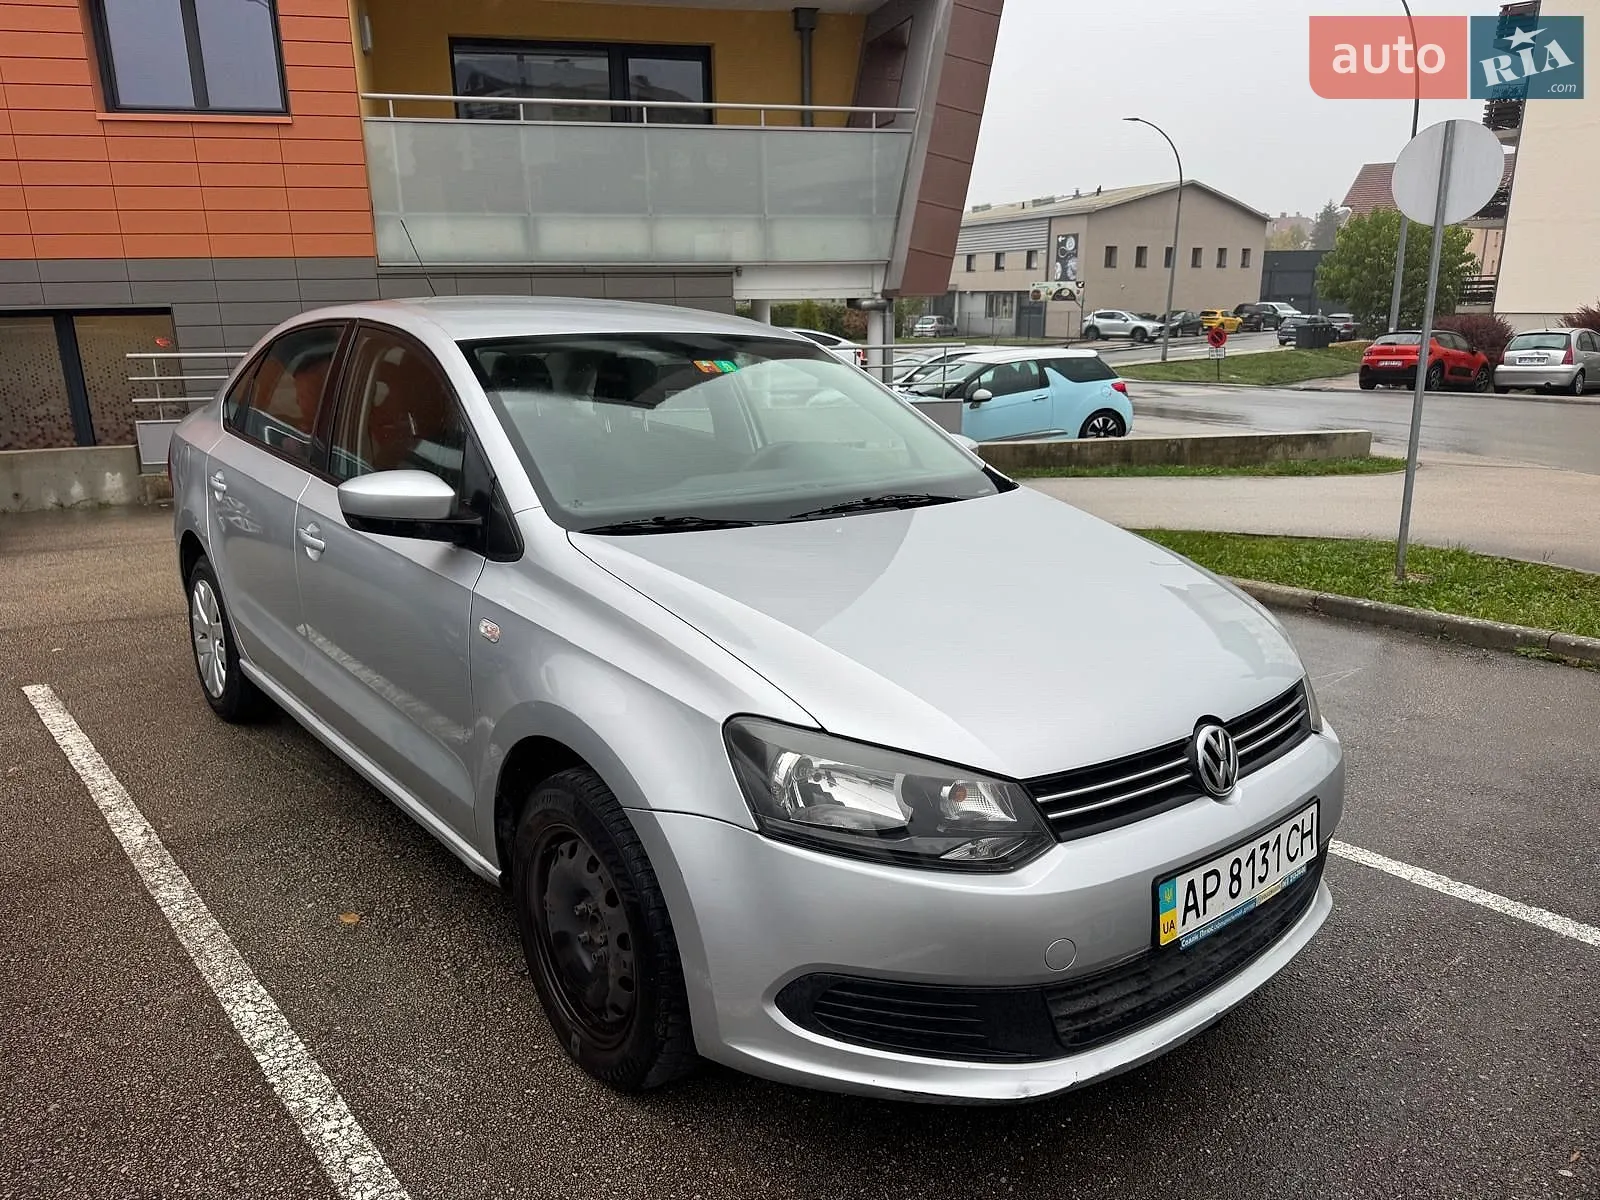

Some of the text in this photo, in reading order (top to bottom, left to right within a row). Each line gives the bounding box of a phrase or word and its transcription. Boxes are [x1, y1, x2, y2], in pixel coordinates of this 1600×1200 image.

[1181, 811, 1314, 927] AP 8131 CH
[1162, 919, 1176, 935] UA
